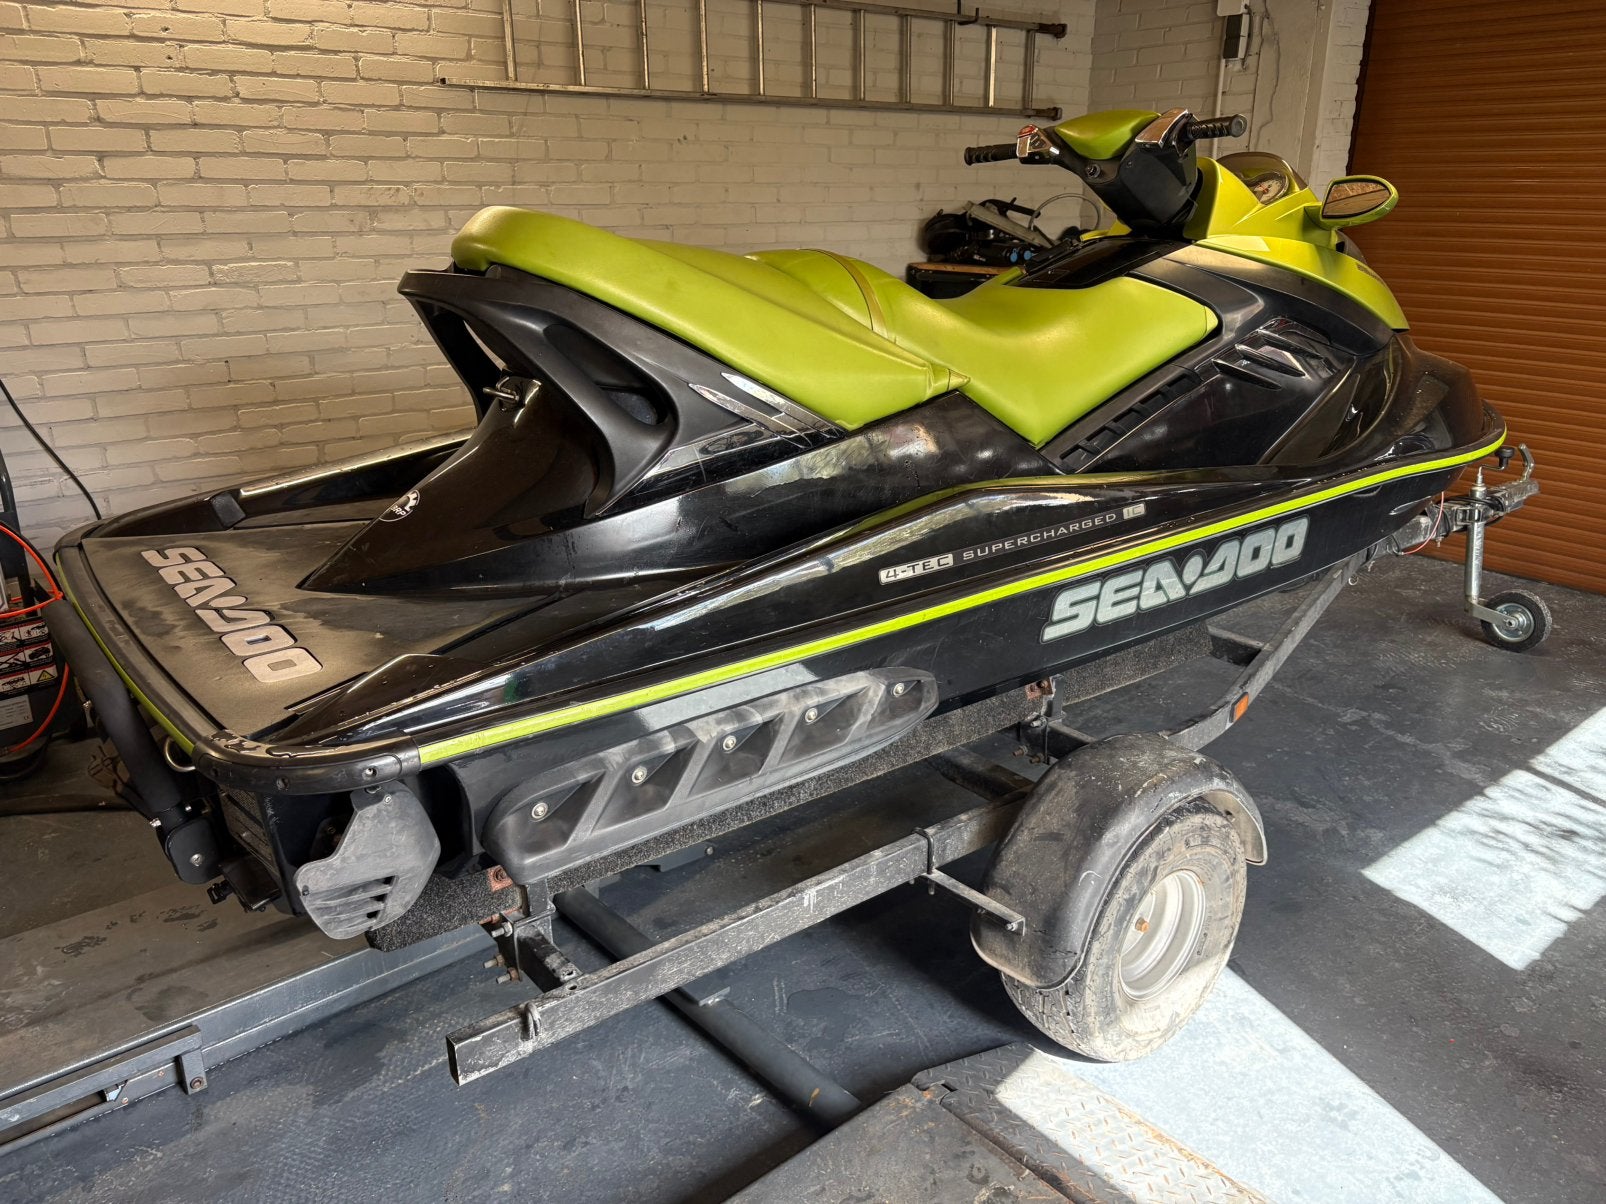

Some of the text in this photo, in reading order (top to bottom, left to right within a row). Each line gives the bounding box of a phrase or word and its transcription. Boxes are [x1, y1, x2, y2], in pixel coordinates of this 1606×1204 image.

[882, 505, 1144, 581] 4-TEC SUPERCHARGED IC
